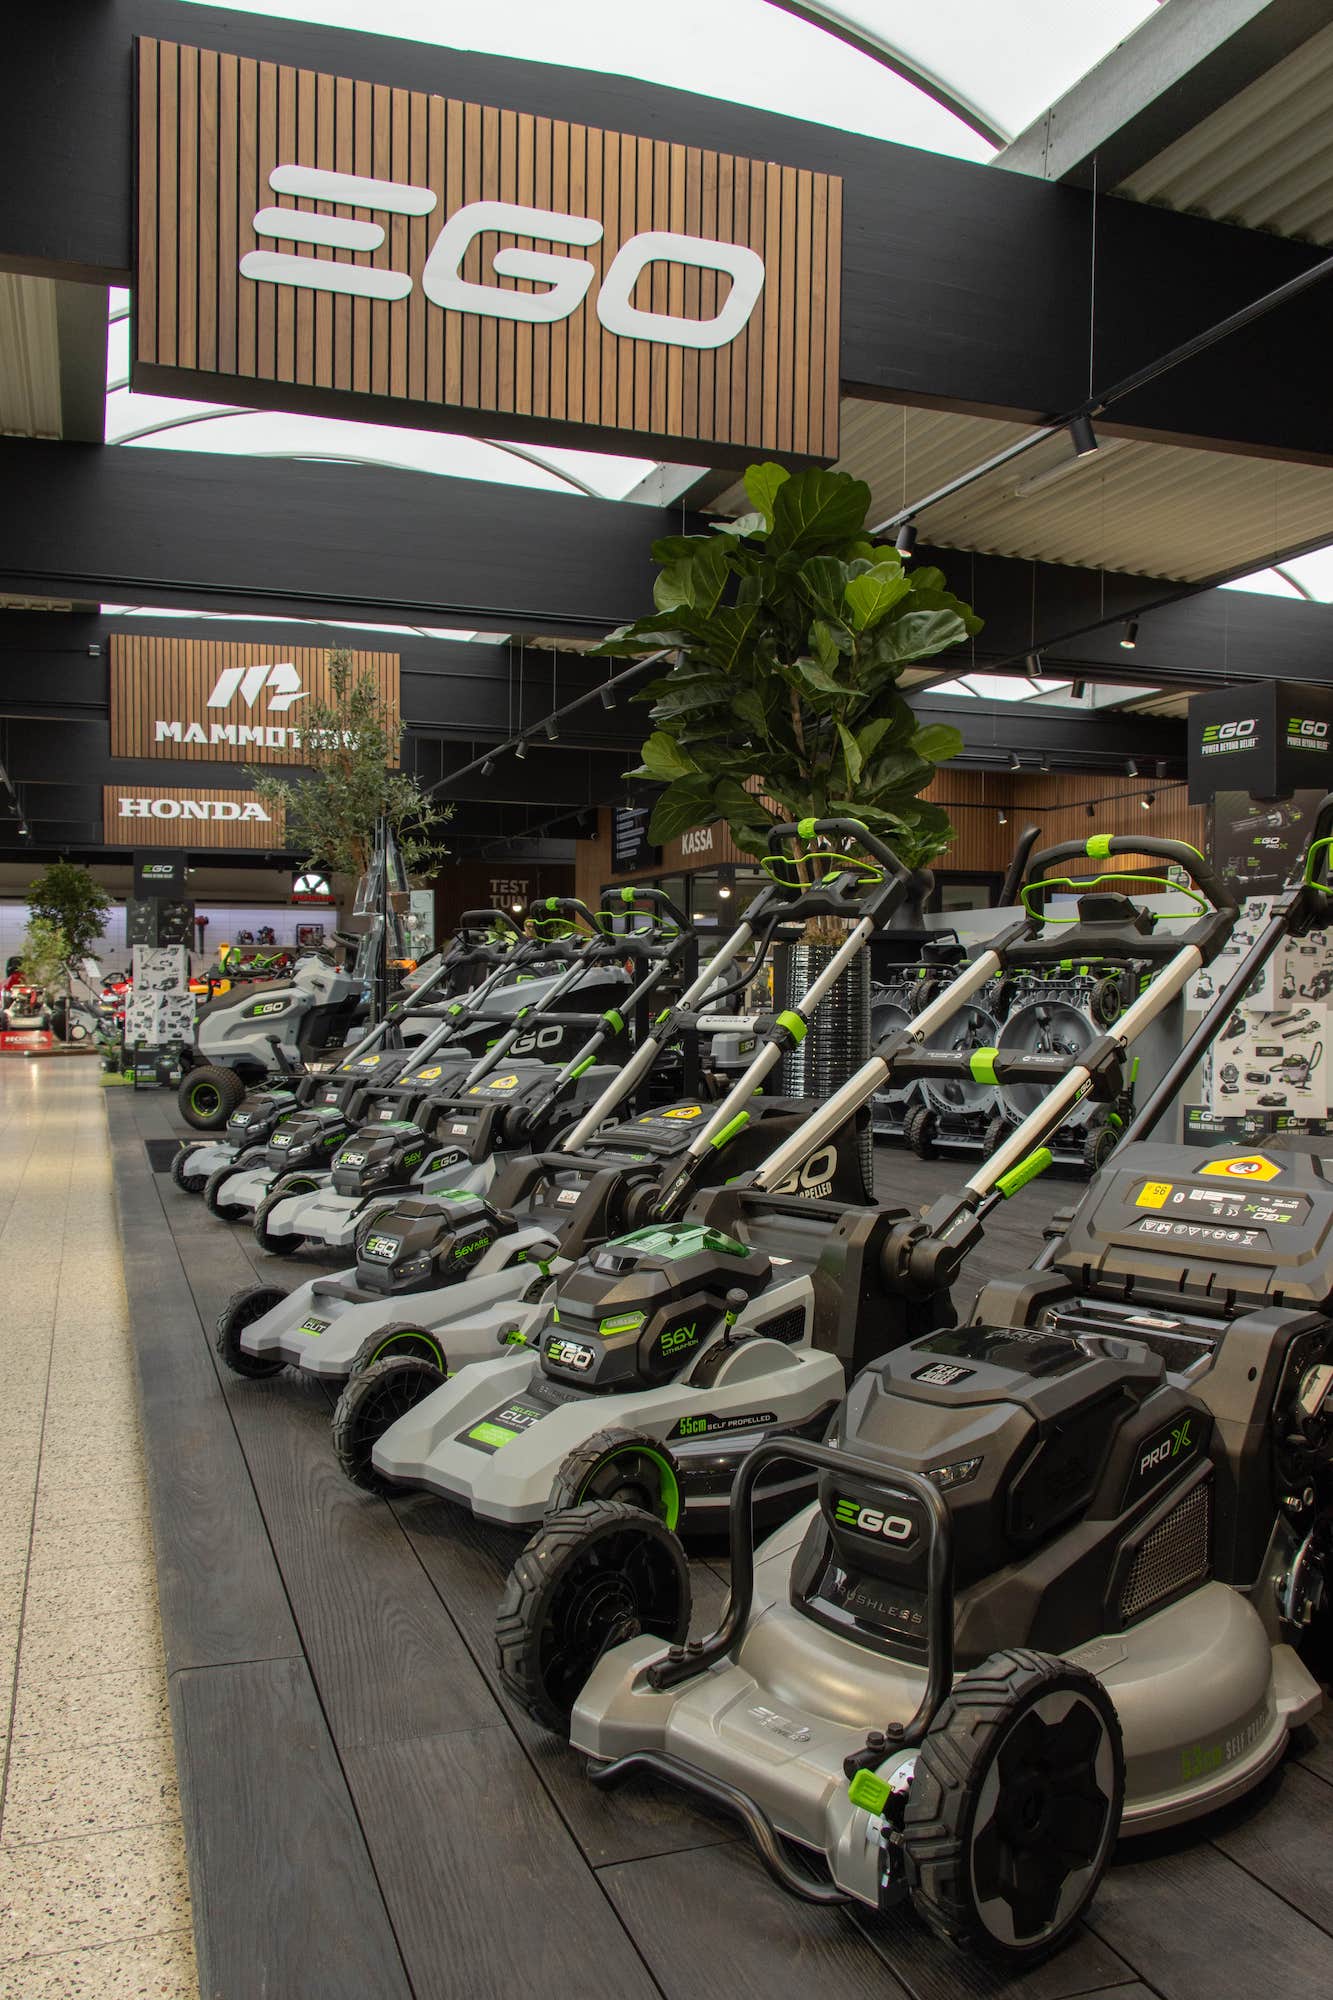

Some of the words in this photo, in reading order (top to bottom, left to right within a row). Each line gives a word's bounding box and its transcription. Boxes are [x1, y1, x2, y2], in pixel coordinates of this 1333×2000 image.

[239, 164, 766, 350] EGO
[155, 720, 360, 750] MAMMOT
[1202, 719, 1256, 742] EGO
[1288, 718, 1328, 737] EGO
[118, 798, 272, 822] HONDA
[681, 827, 713, 856] KASSA
[1253, 837, 1280, 845] EGO
[143, 864, 174, 873] EGO
[490, 880, 529, 893] TEST
[254, 1002, 284, 1015] EGO
[431, 1153, 458, 1171] EGO
[1252, 1212, 1292, 1223] EGO
[366, 1237, 399, 1252] EGO
[454, 1243, 475, 1259] 56V
[303, 1321, 328, 1333] CUT
[660, 1322, 697, 1350] 56V
[548, 1342, 594, 1370] EGO
[499, 1410, 539, 1427] CUT
[680, 1417, 707, 1435] 55cm
[727, 1414, 771, 1428] PROPELLED
[1140, 1439, 1171, 1476] PRO
[1171, 1419, 1191, 1457] X
[835, 1499, 912, 1540] EGO
[833, 1580, 922, 1624] RUSHLESS
